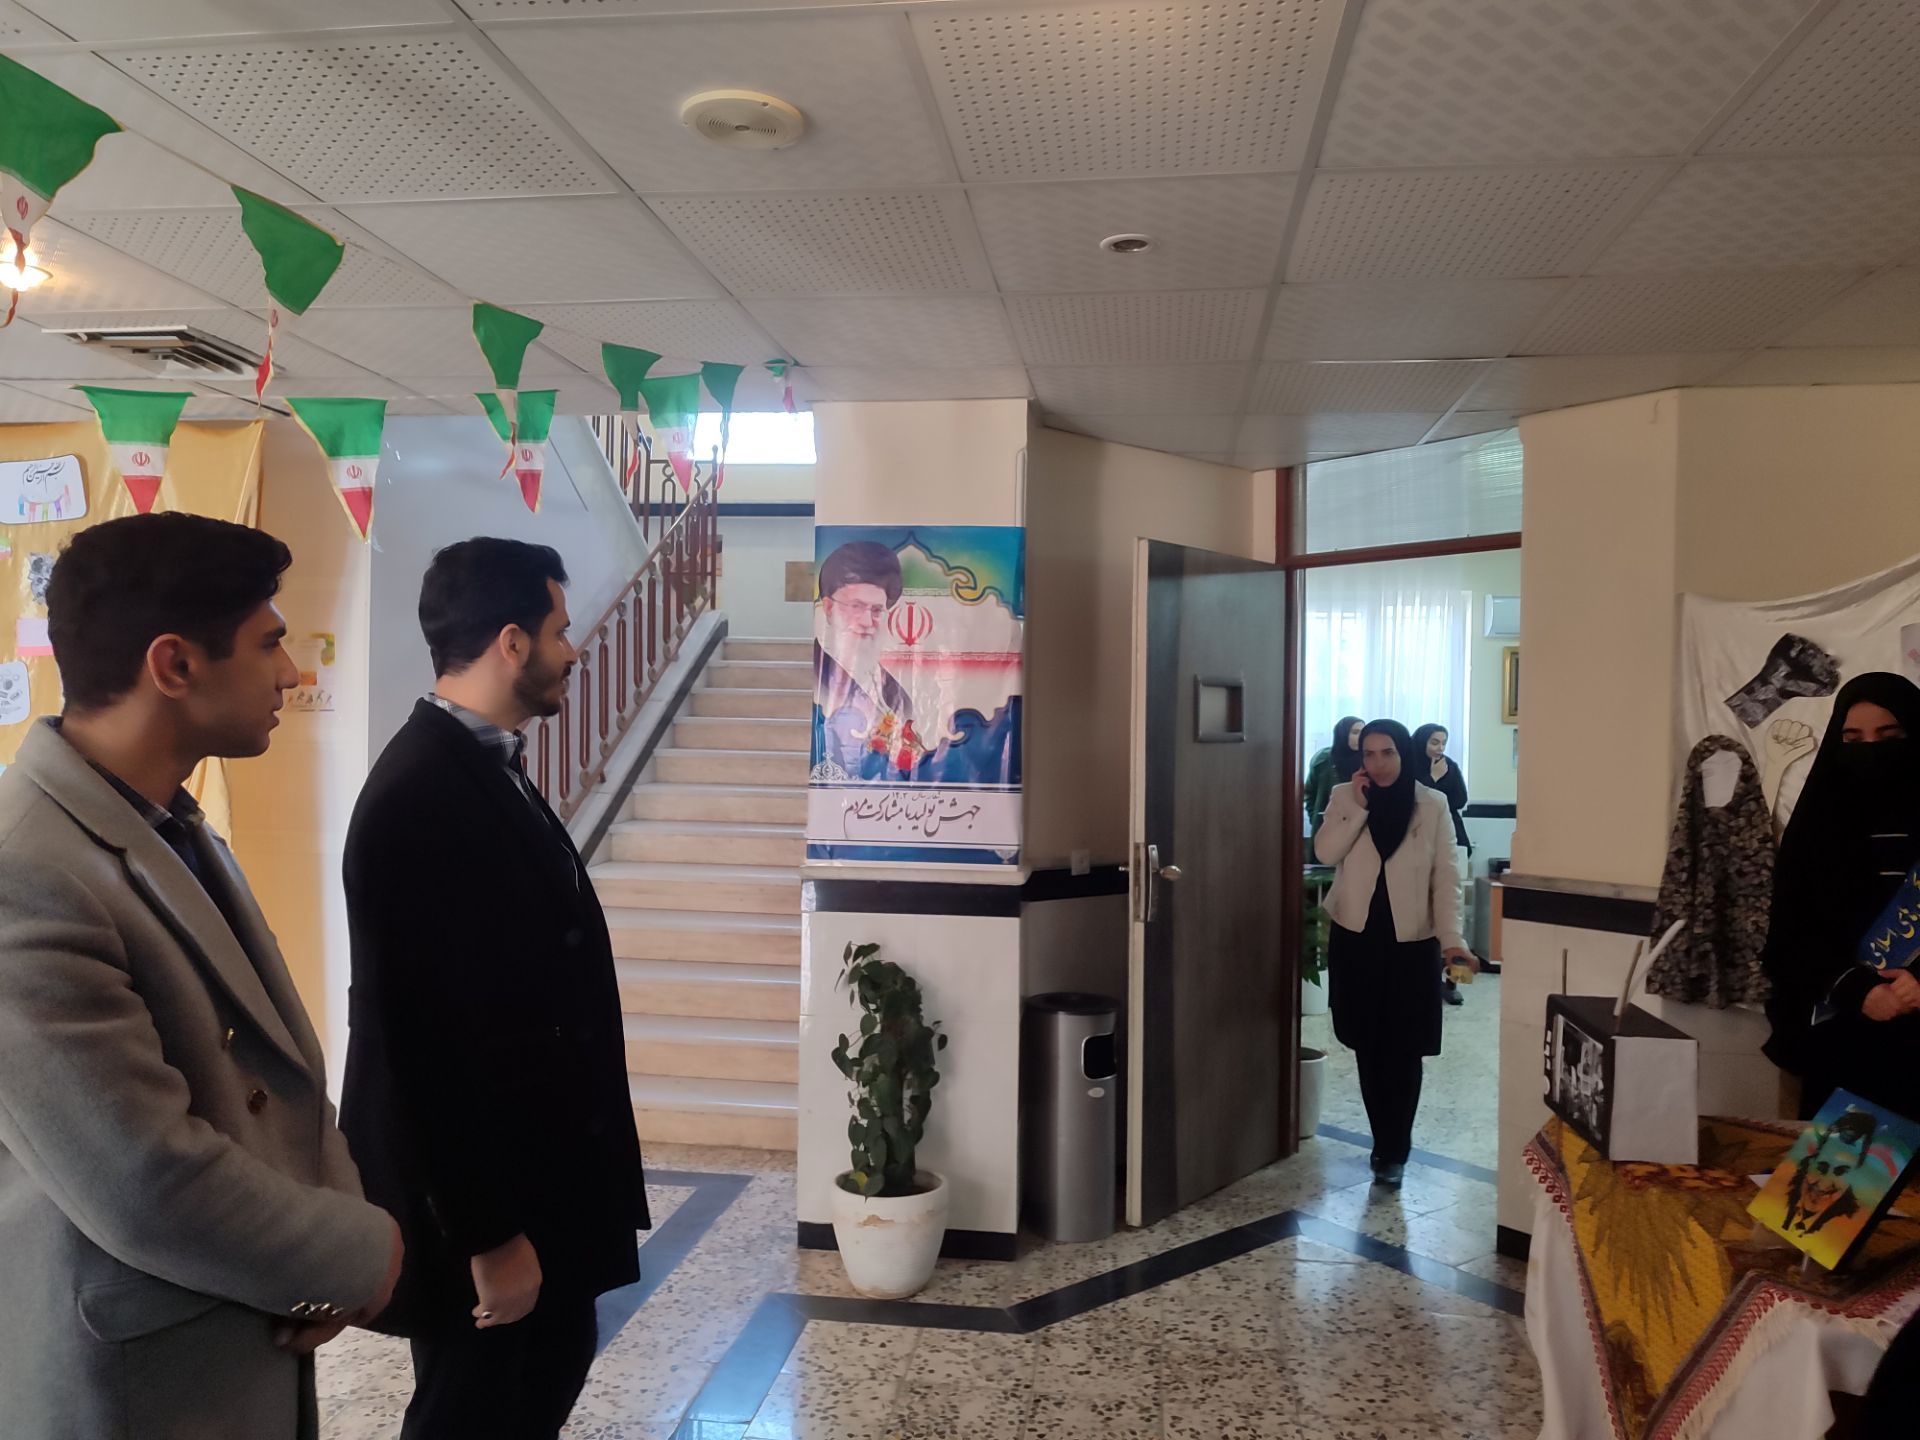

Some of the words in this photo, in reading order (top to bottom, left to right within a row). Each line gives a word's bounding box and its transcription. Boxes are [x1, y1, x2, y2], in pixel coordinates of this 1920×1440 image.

[843, 798, 868, 839] مردم
[857, 794, 903, 822] مشارکت
[908, 799, 945, 831] تولید
[924, 797, 981, 838] جهش
